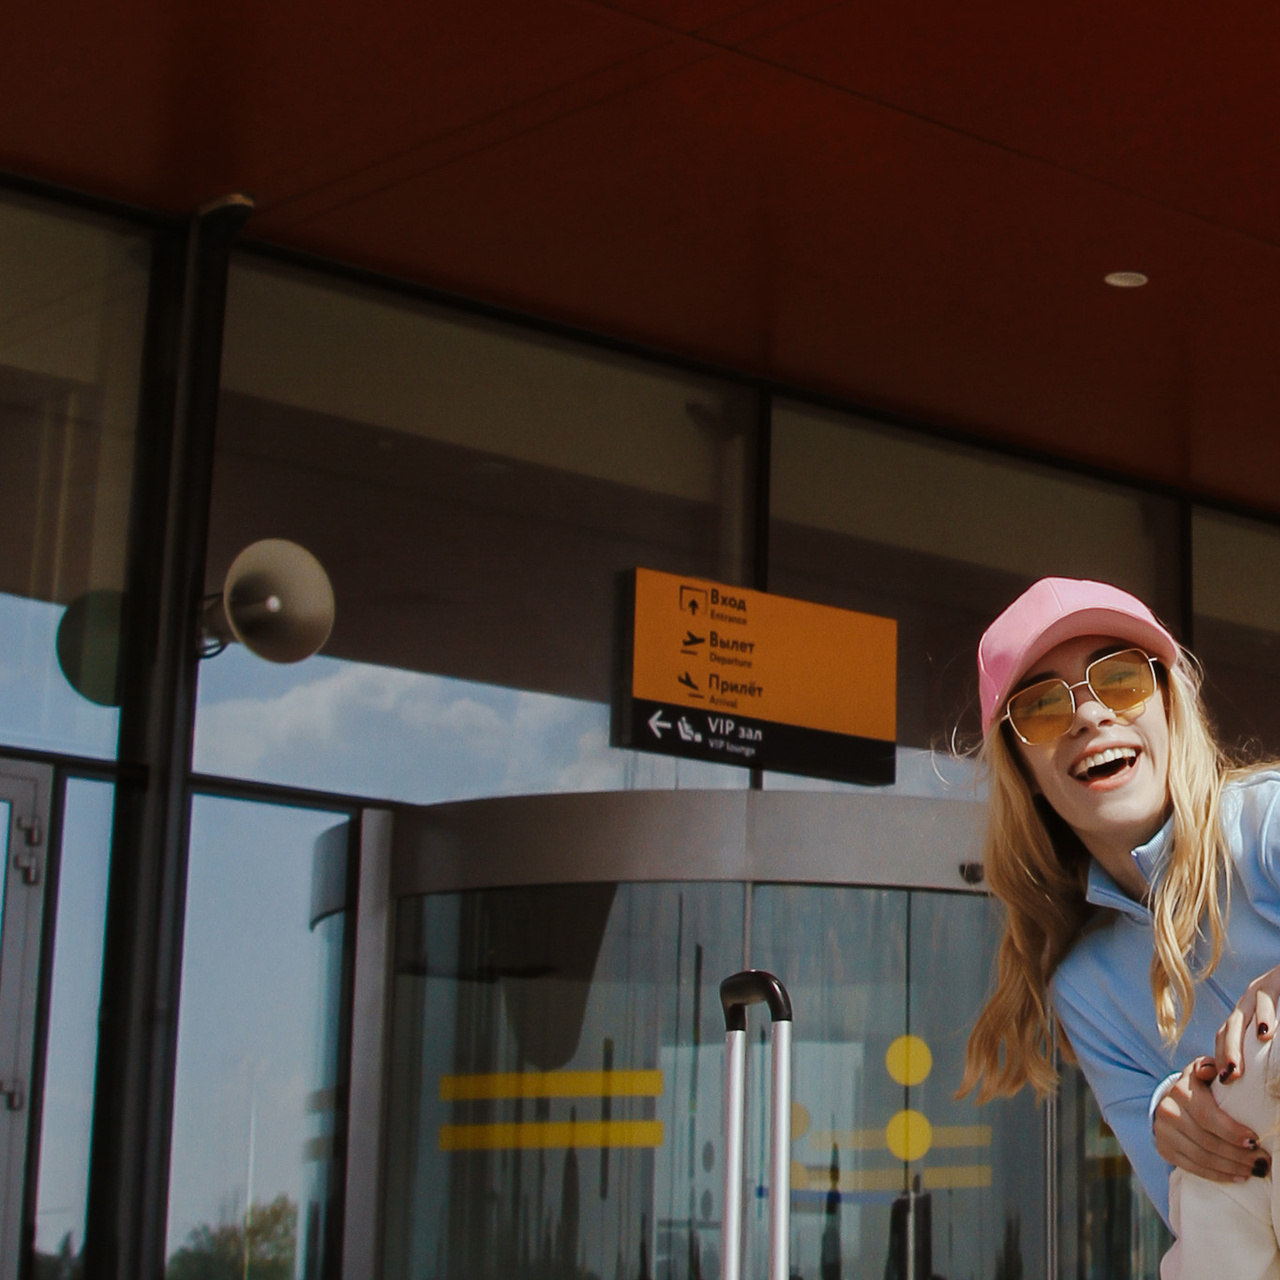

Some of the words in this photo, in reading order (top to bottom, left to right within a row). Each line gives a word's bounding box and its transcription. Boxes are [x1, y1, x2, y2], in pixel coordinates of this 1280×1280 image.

[710, 588, 746, 612] Вход
[709, 631, 755, 653] Вылет
[708, 673, 763, 697] Прилёт
[707, 716, 735, 735] VIP
[738, 725, 763, 741] зал
[708, 738, 725, 749] VIP
